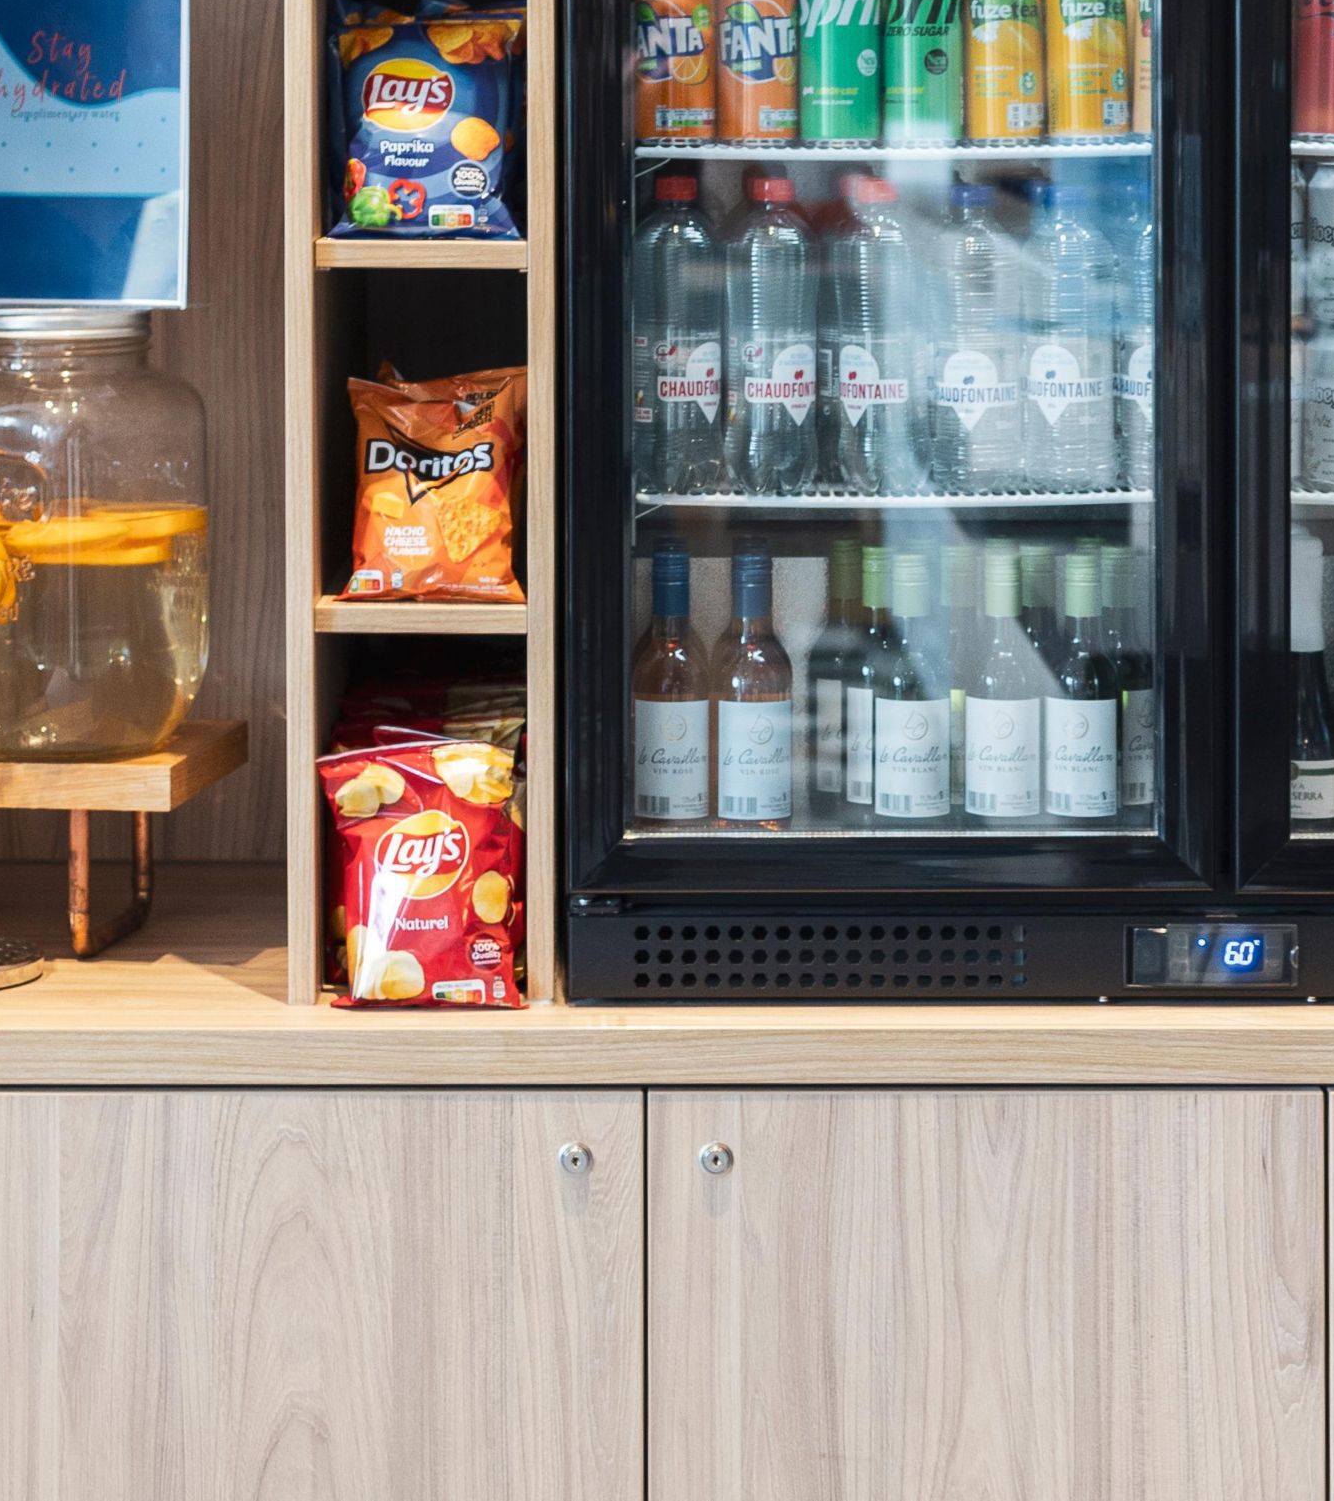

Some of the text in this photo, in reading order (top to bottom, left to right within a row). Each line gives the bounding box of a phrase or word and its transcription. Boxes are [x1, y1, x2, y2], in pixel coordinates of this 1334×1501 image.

[971, 0, 1012, 19] fuze
[636, 16, 704, 58] ANTA
[912, 26, 950, 37] SUGAR
[25, 30, 92, 73] Stay
[368, 75, 449, 114] Lay's
[380, 140, 435, 154] Paprika
[384, 156, 429, 168] Flavour
[367, 441, 493, 478] Doritos
[383, 828, 463, 878] Lay's
[394, 914, 449, 931] Naturel
[472, 942, 500, 952] 100%
